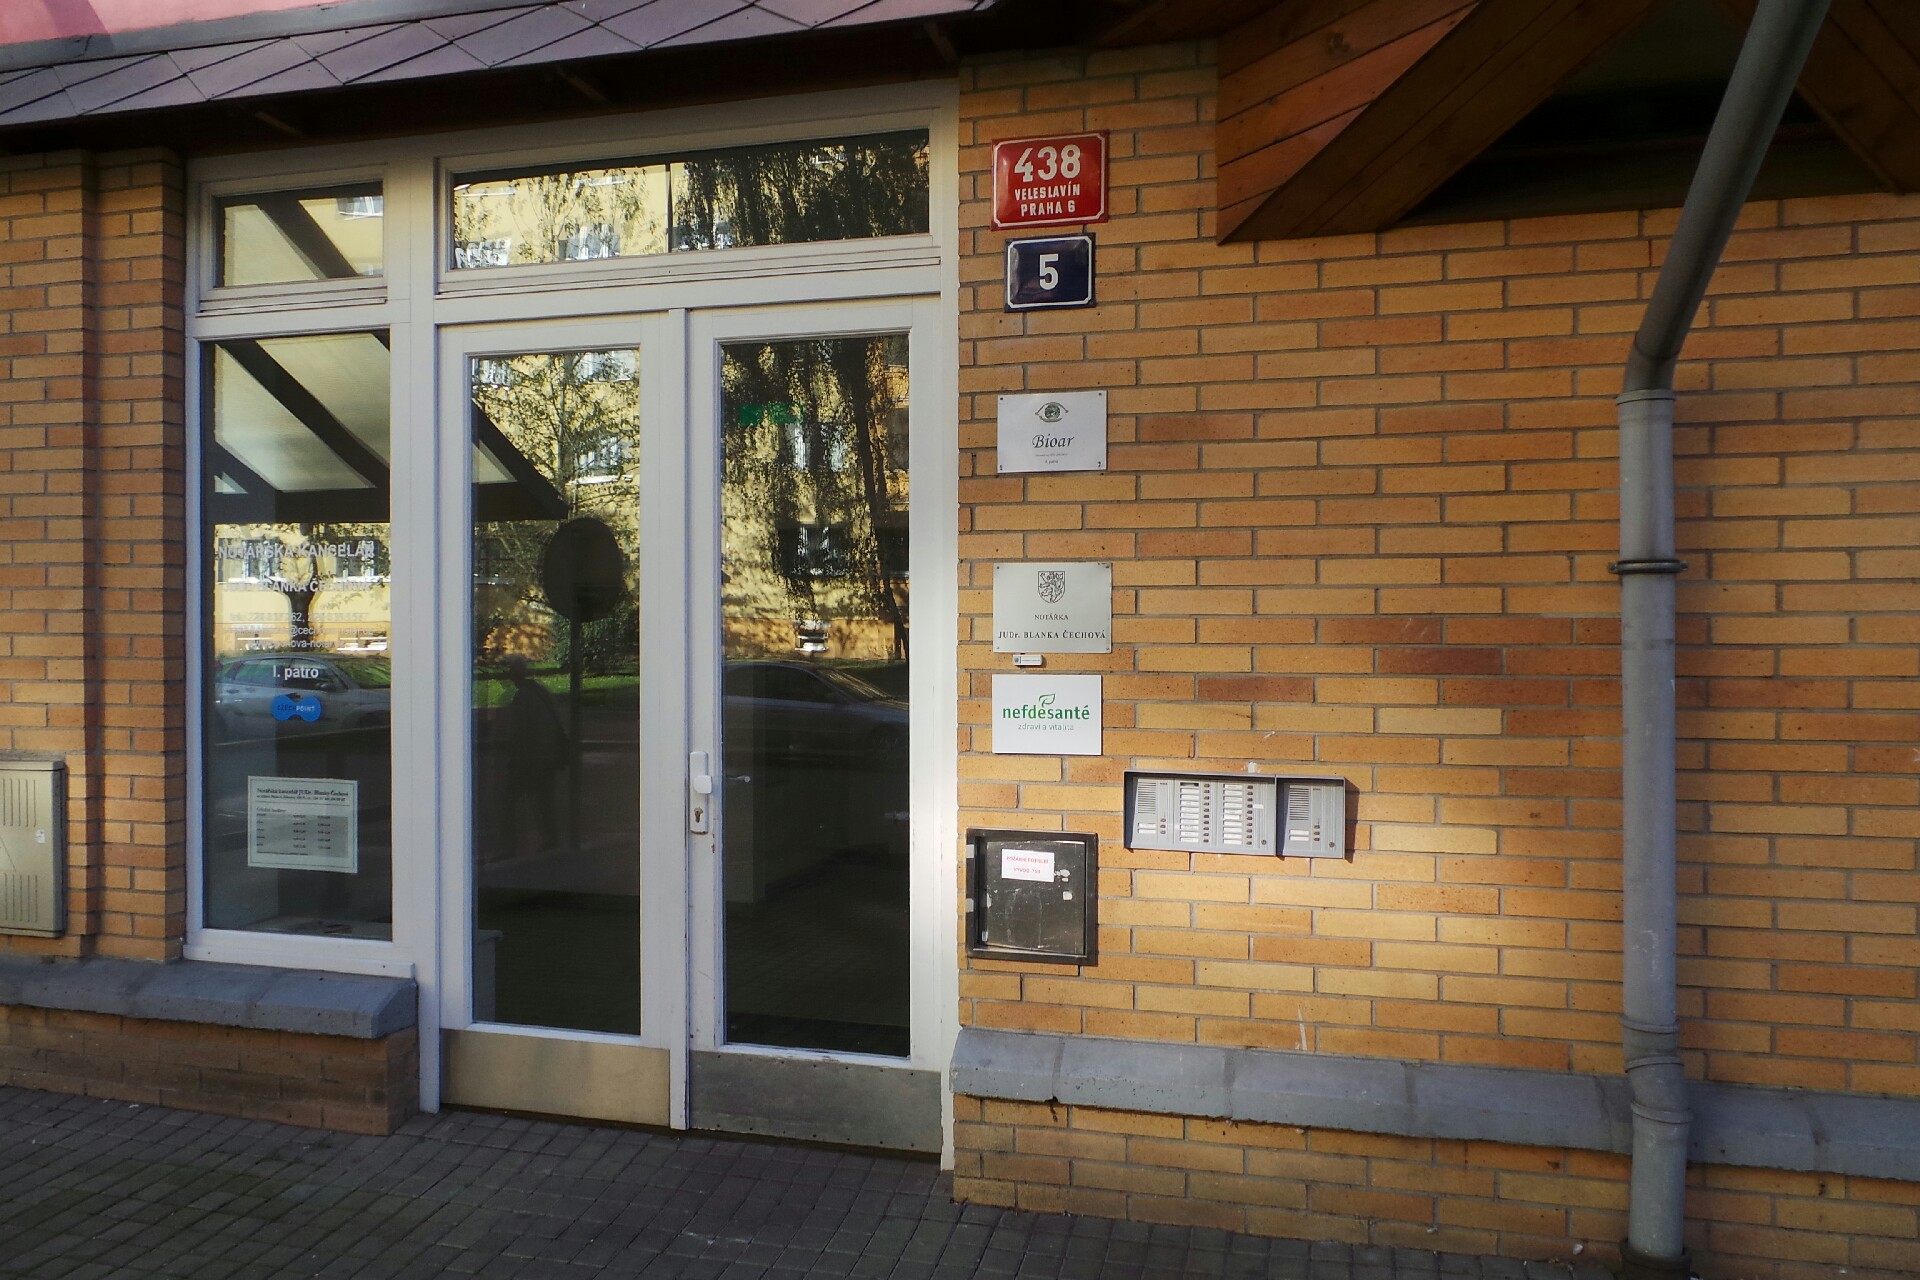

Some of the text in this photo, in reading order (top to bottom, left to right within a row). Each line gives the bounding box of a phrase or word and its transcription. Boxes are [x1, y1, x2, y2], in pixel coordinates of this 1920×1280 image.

[1014, 144, 1081, 182] 438
[1015, 181, 1080, 201] VELESLAVÍN
[1021, 200, 1076, 217] PRAHA 6
[1039, 253, 1059, 290] 5
[1032, 433, 1075, 448] Bioar
[1034, 613, 1069, 621] NOTÁŘKA
[998, 629, 1106, 639] JUDr. BLANKA ČECHOVÁ
[284, 665, 319, 680] patro
